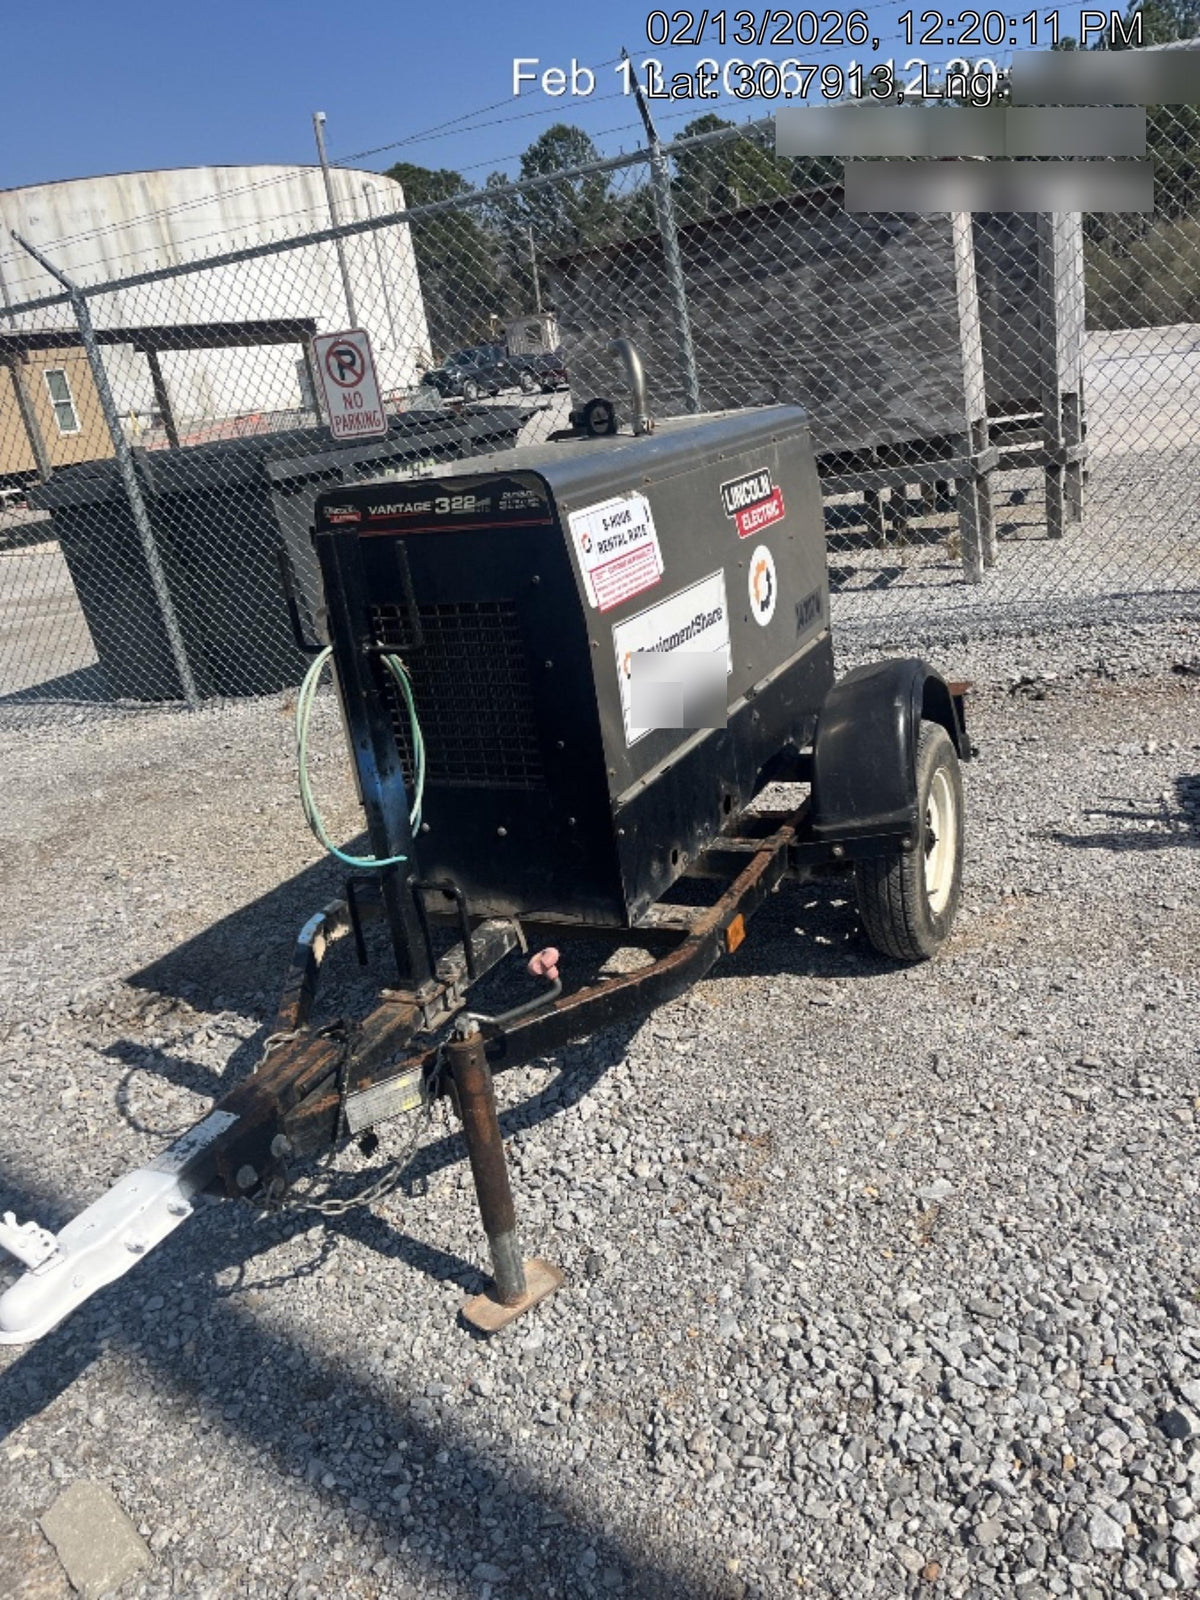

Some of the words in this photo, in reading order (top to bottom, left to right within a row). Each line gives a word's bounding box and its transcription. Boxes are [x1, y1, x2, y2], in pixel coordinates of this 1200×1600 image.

[342, 391, 364, 410] NO
[334, 410, 381, 432] PARKING
[368, 500, 432, 516] VANTAGE
[434, 495, 476, 514] 322
[724, 473, 771, 512] LINCOLN
[741, 500, 780, 530] ELECTRIC
[597, 532, 629, 554] RENTAL
[627, 524, 648, 541] RATE
